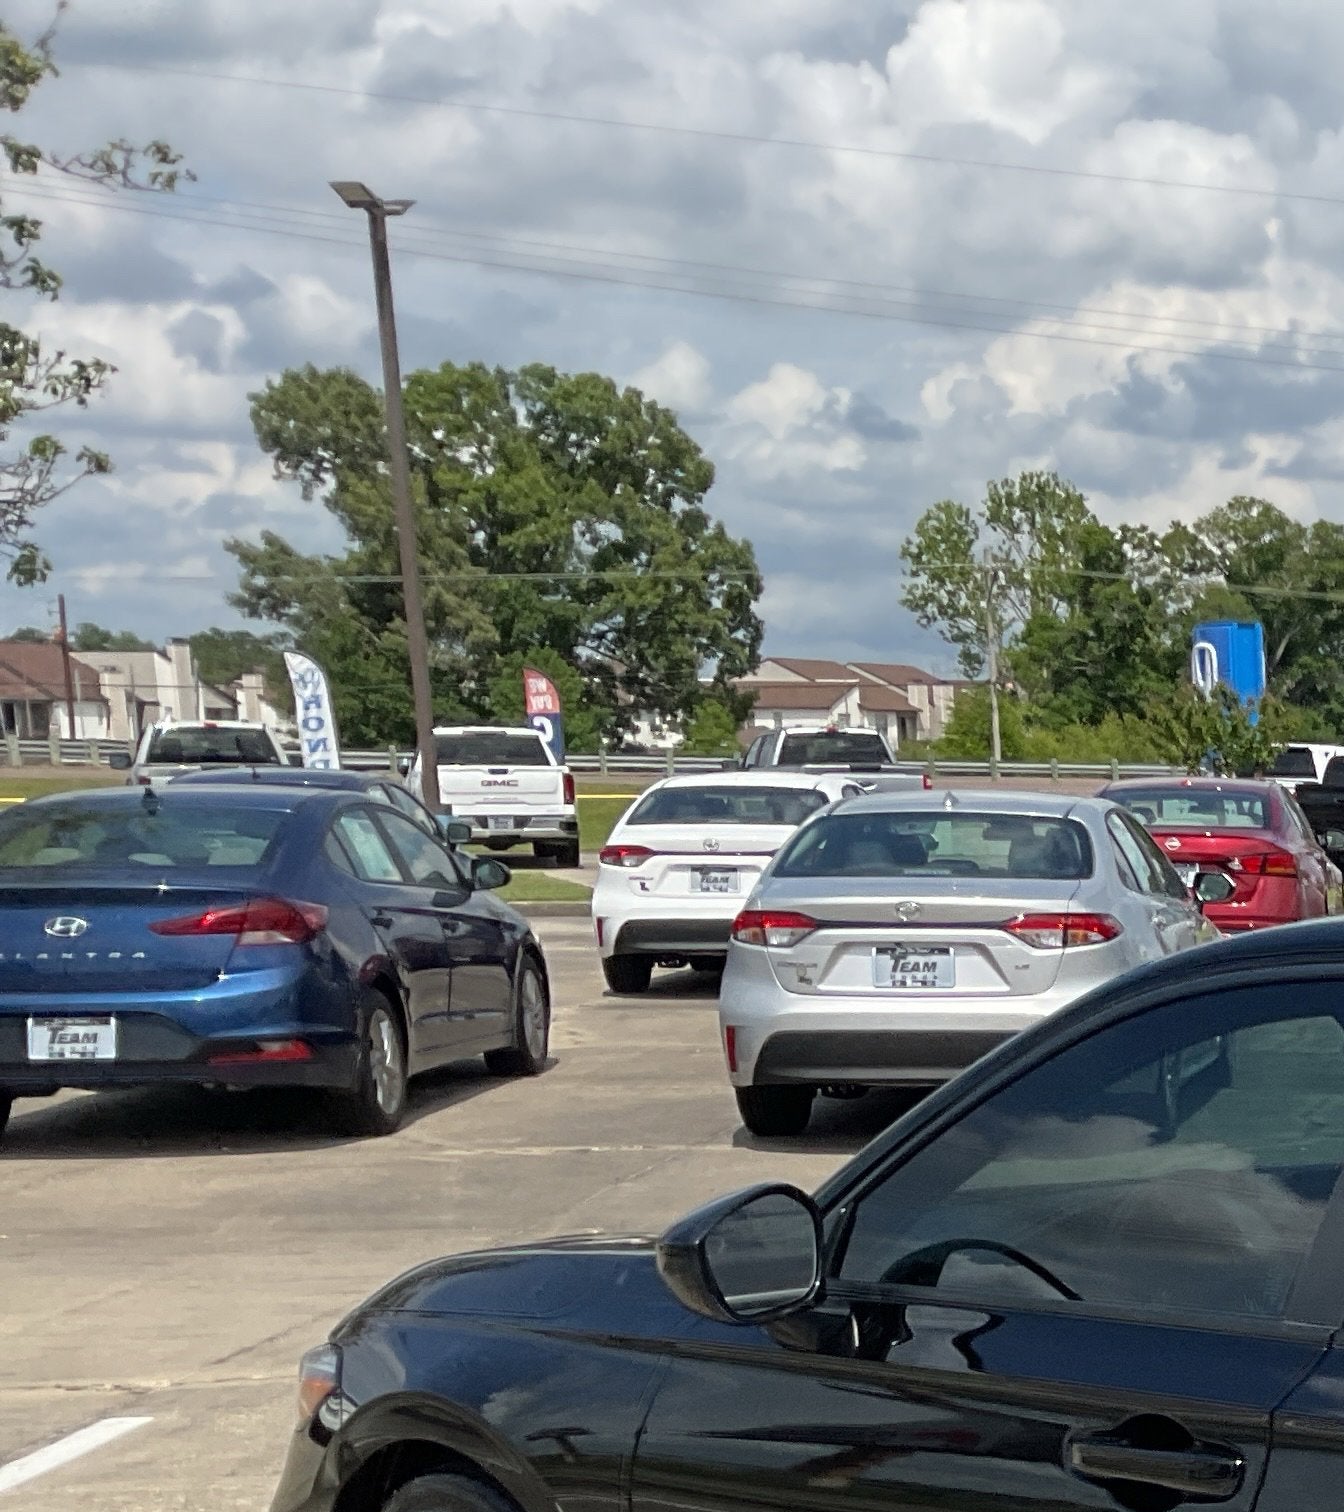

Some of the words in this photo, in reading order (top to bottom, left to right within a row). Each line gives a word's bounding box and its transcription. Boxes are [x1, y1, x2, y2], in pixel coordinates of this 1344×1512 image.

[480, 779, 519, 787] GMC
[890, 955, 938, 973] TEAM
[48, 1024, 99, 1045] TEAM
